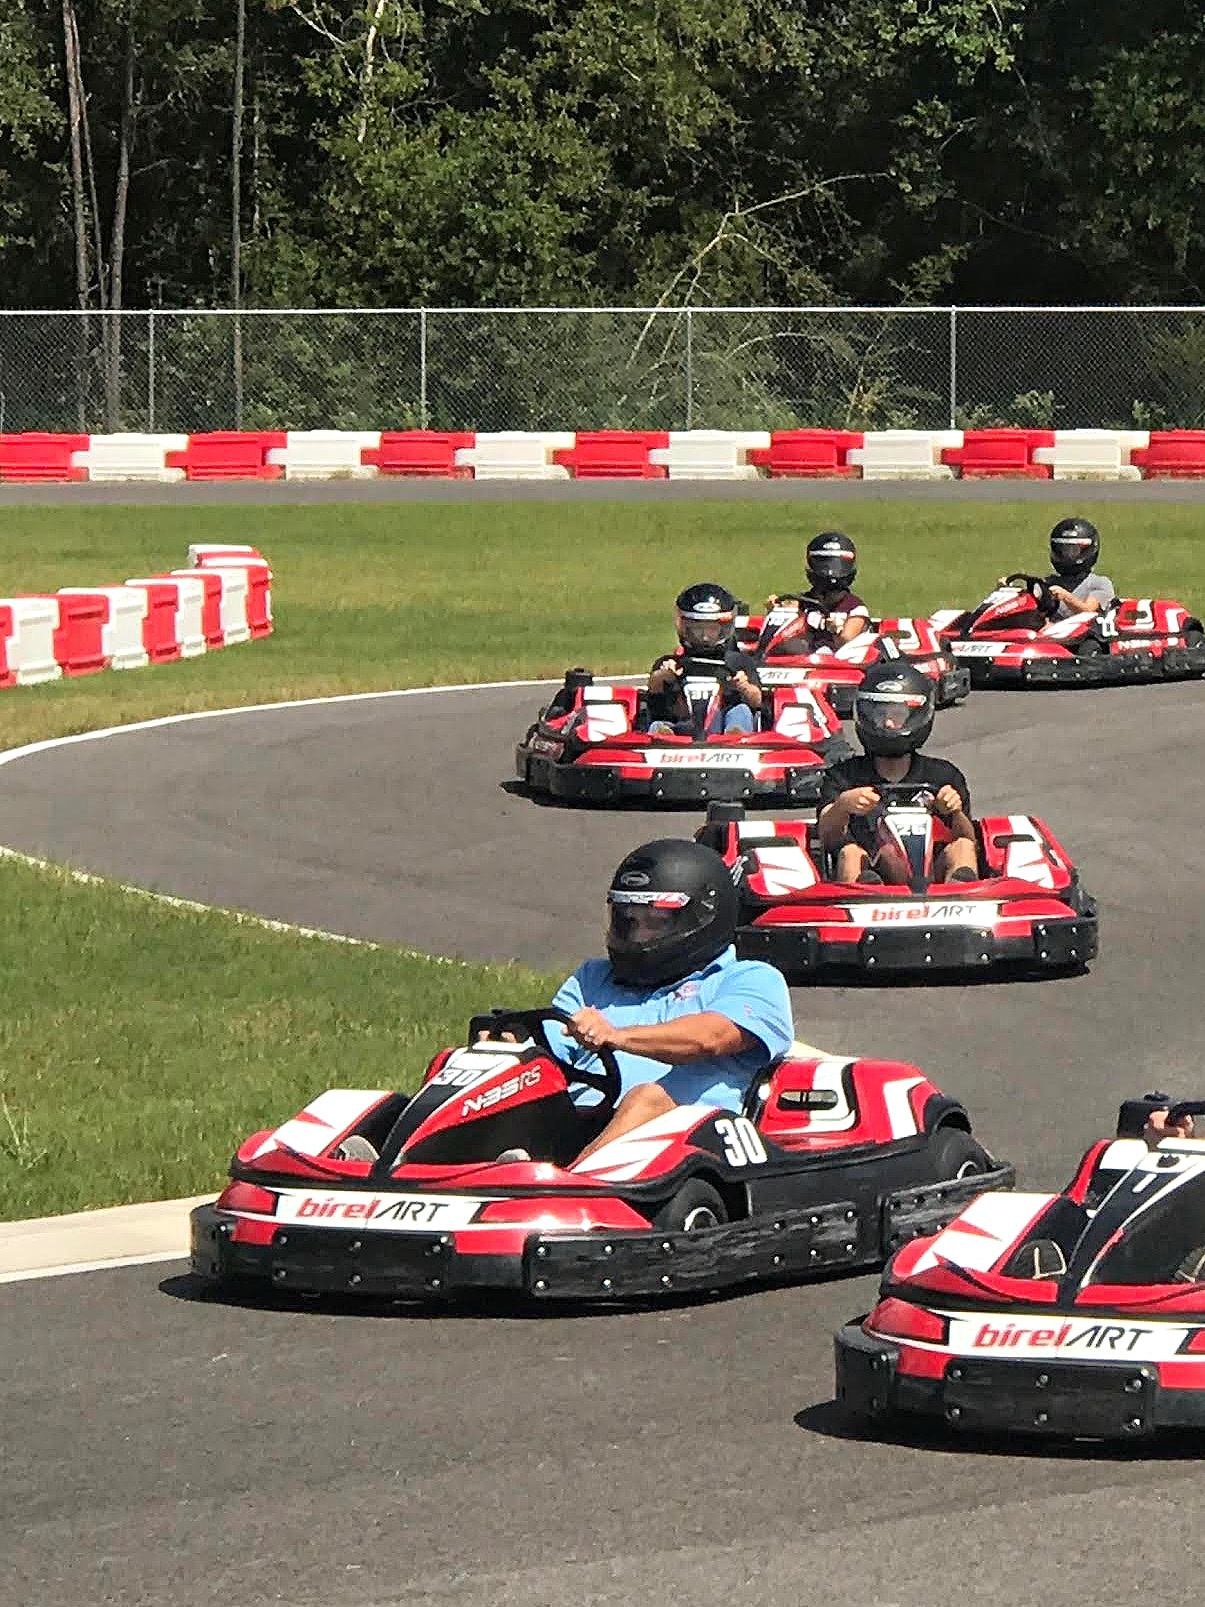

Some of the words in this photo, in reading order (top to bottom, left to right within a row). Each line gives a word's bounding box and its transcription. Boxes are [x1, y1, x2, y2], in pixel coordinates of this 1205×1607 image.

[871, 903, 977, 923] birelART
[432, 1067, 488, 1086] 30
[714, 1117, 769, 1167] 30
[296, 1196, 450, 1223] birelART
[971, 1322, 1154, 1351] birelART
